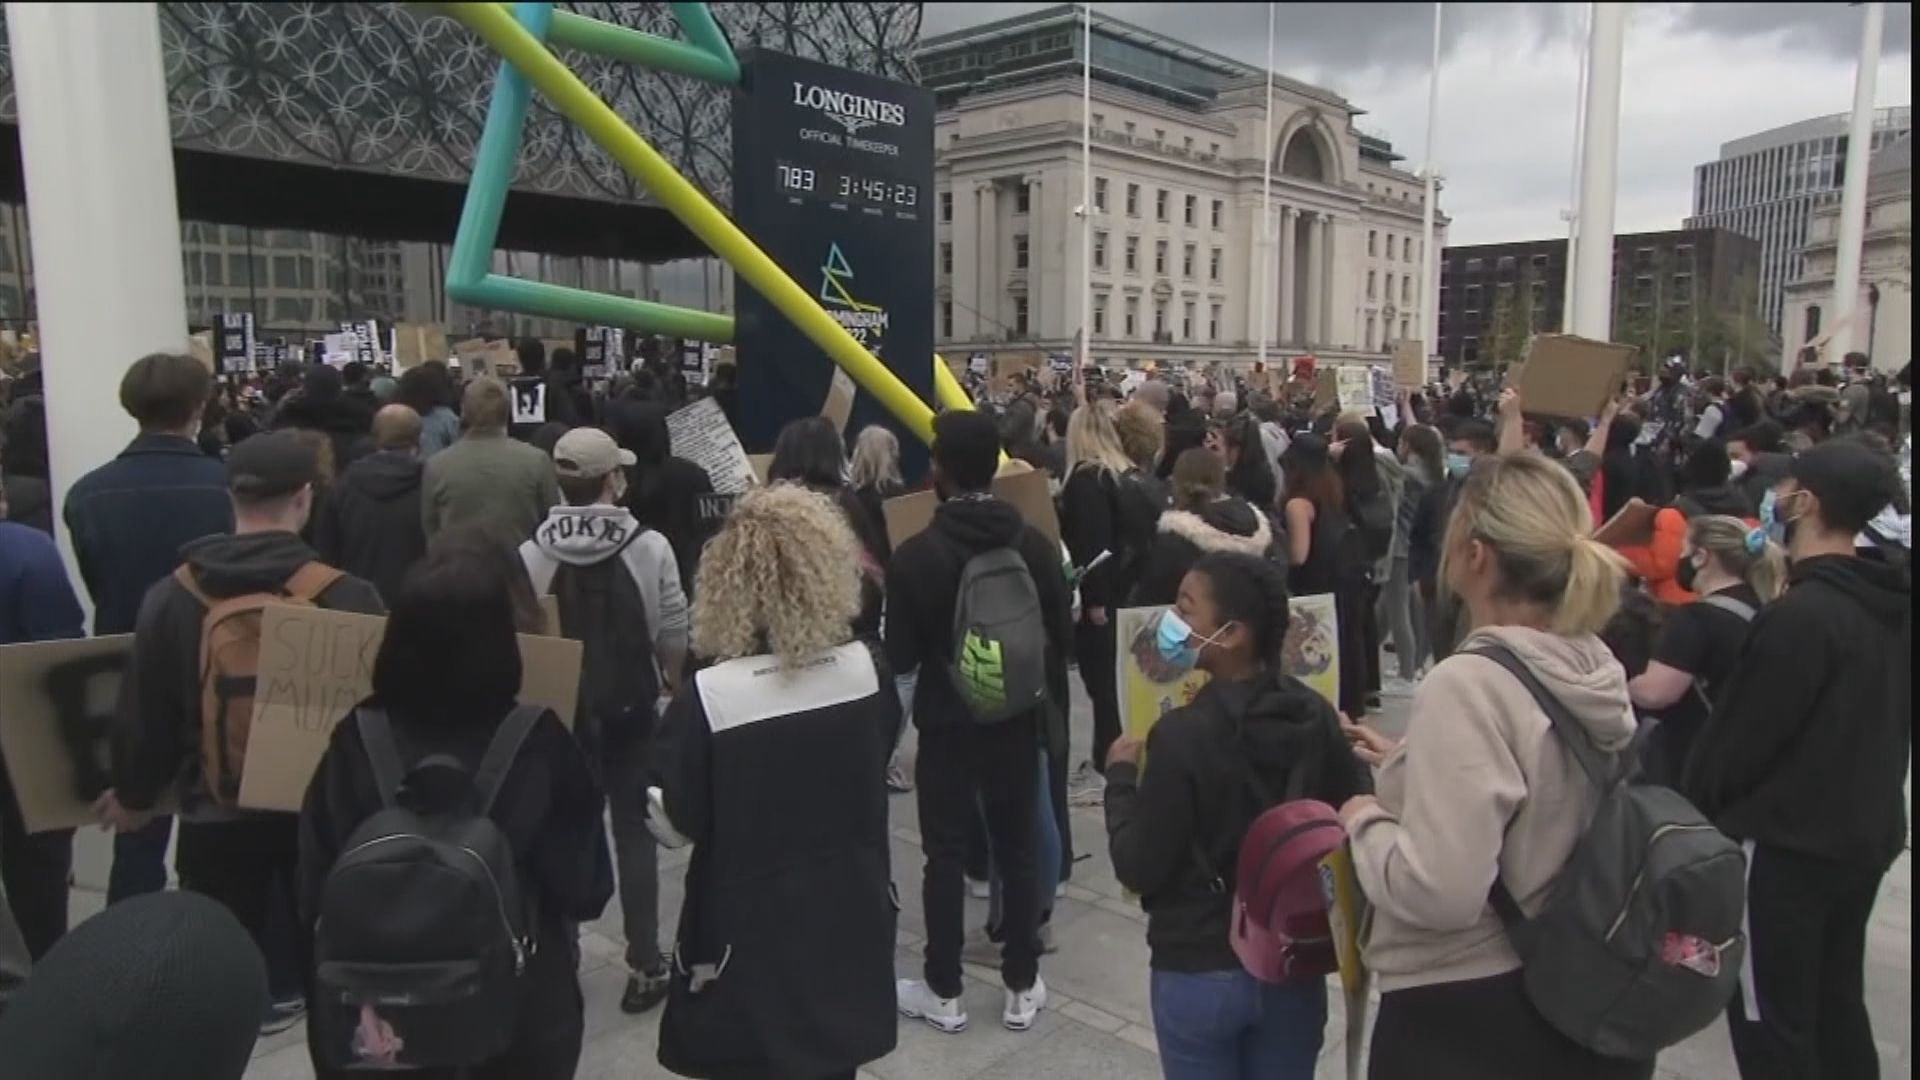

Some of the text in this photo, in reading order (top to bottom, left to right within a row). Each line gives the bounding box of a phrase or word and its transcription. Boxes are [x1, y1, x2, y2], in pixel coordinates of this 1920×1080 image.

[793, 81, 905, 125] LONGINES
[800, 128, 842, 146] OFFICIAL
[778, 165, 917, 205] 783 3:45:23
[542, 515, 626, 545] TOKYO
[274, 617, 378, 680] SUCK
